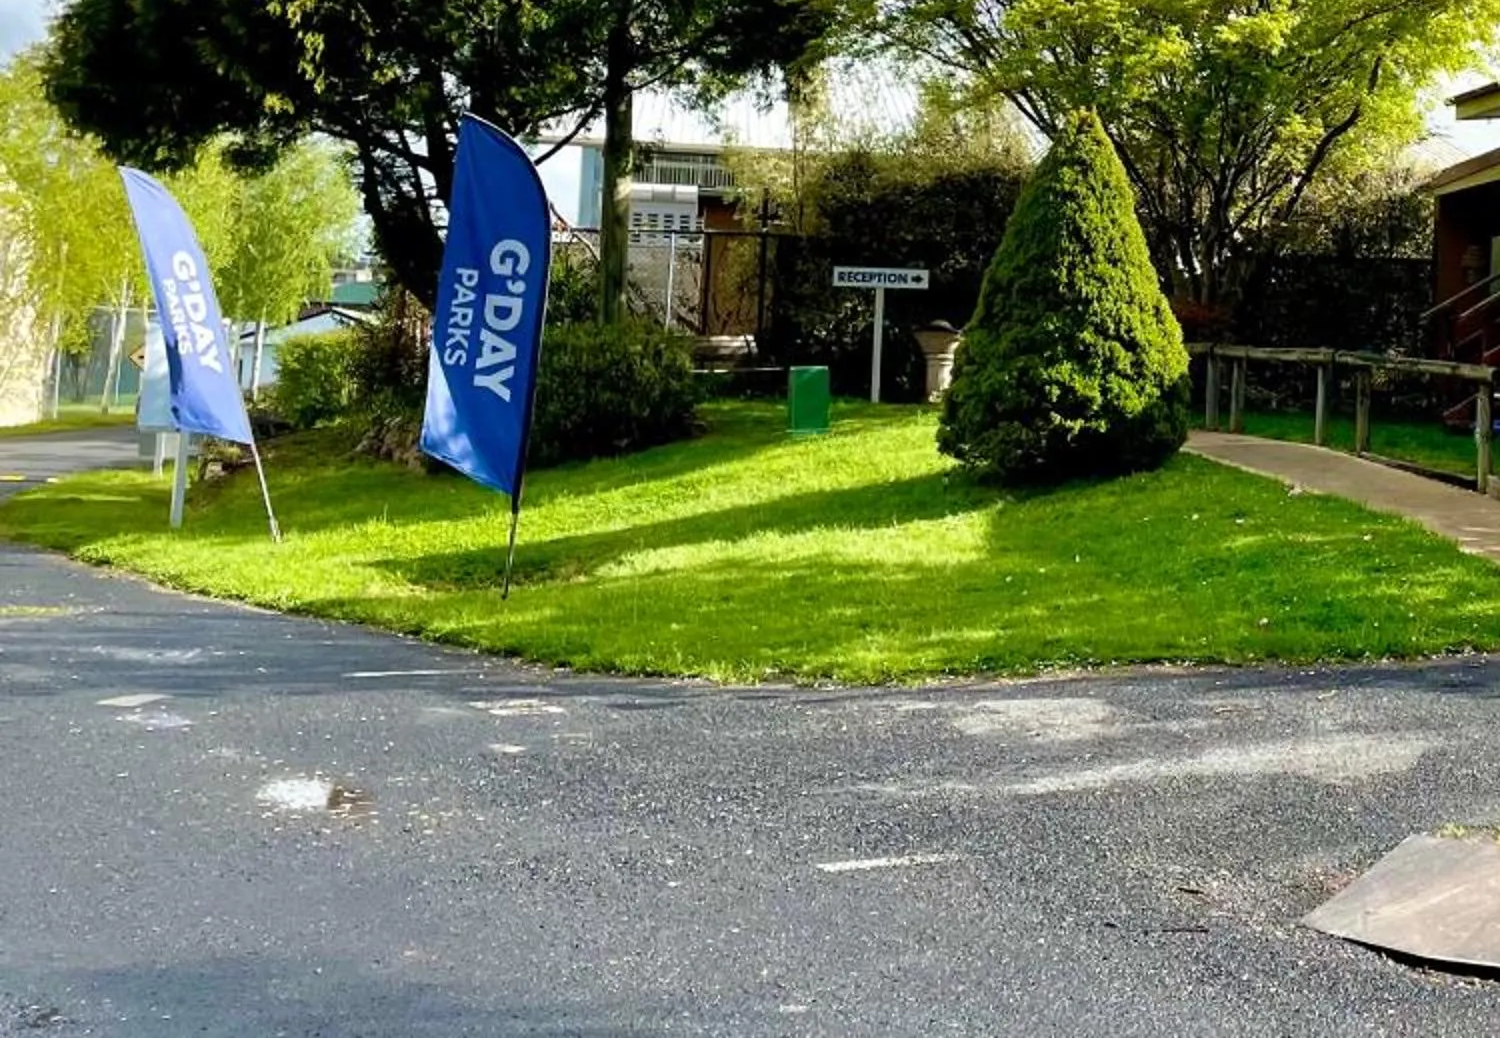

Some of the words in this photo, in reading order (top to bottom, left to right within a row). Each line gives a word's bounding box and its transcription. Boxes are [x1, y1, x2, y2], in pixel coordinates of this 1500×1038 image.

[162, 278, 193, 355] PARKS
[172, 250, 223, 374] G'DAY
[444, 267, 480, 366] PARKS
[474, 239, 530, 402] G'DAY
[837, 271, 908, 284] RECEPTION
